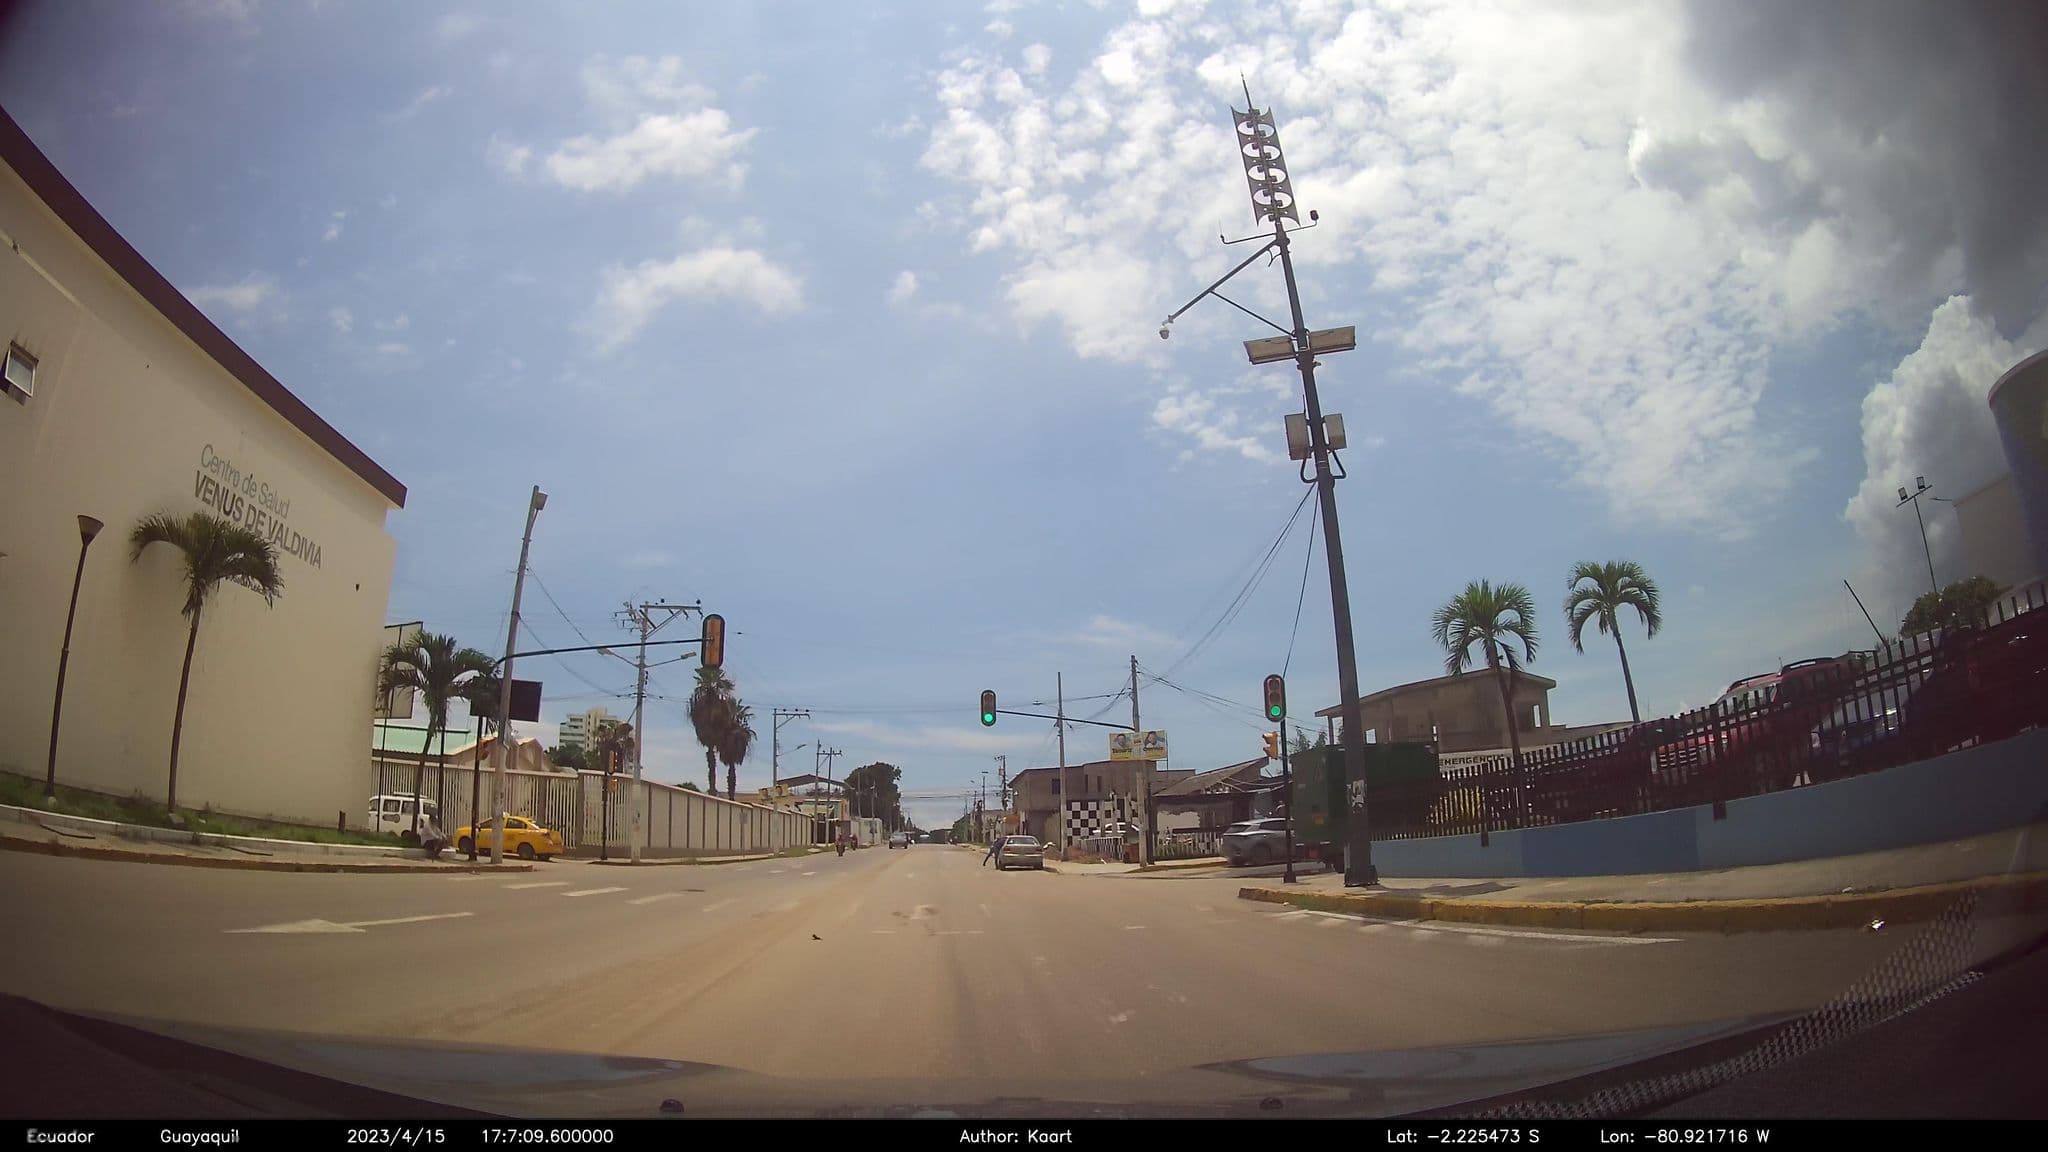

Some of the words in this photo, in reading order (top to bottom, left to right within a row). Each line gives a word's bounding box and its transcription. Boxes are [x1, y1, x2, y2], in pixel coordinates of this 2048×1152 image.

[194, 470, 244, 522] VENUS
[244, 503, 267, 537] DE
[265, 516, 321, 570] VALDIVIA
[200, 444, 241, 488] Centro
[241, 473, 257, 498] de
[258, 482, 291, 519] Salud
